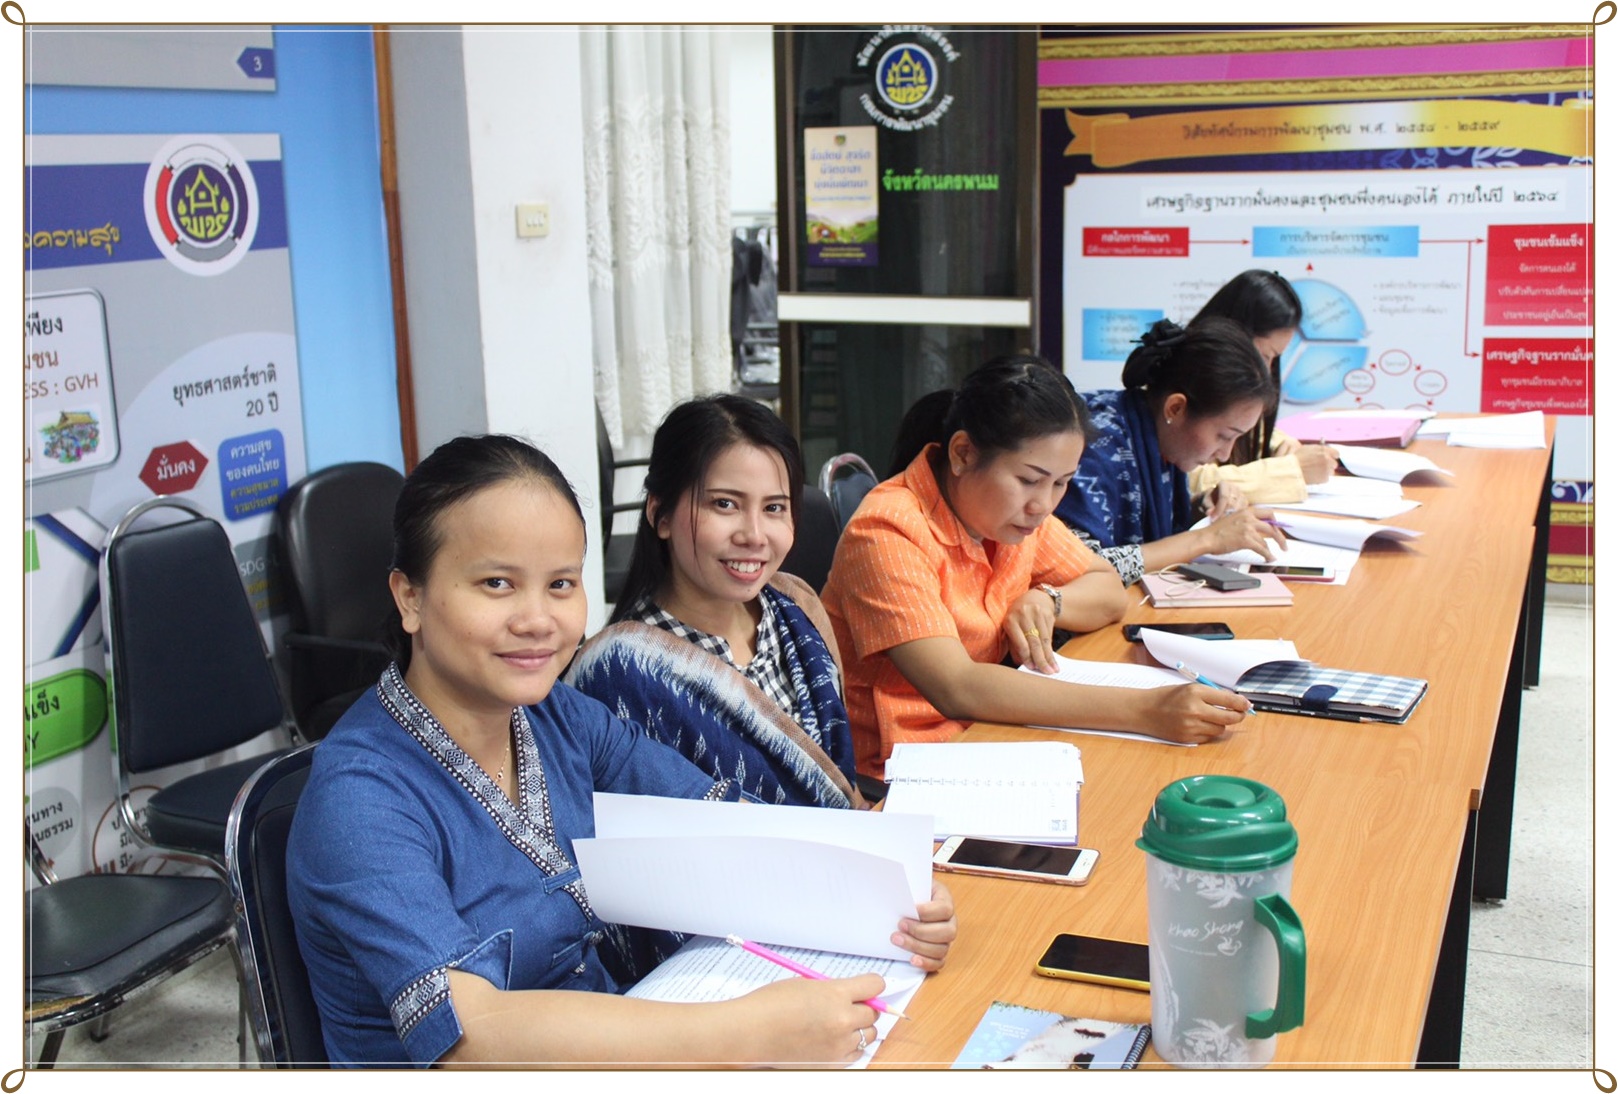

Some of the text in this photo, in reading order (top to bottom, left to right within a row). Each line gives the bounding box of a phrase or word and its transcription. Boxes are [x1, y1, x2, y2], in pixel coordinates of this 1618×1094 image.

[252, 55, 263, 72] 3
[882, 168, 999, 192] จังหวัดนครพนม
[1446, 184, 1504, 205] ภายในปี
[1512, 232, 1584, 251] ชุมชนเข้มแข็ง
[25, 311, 63, 337] พียง
[64, 371, 99, 393] GVH
[172, 362, 278, 408] ยุทธศาสตร์ชาติ
[246, 391, 280, 418] 20 ปี
[230, 439, 273, 460] ความสุข
[156, 454, 197, 481] มั่นคง
[225, 455, 281, 481] ของคนไทย
